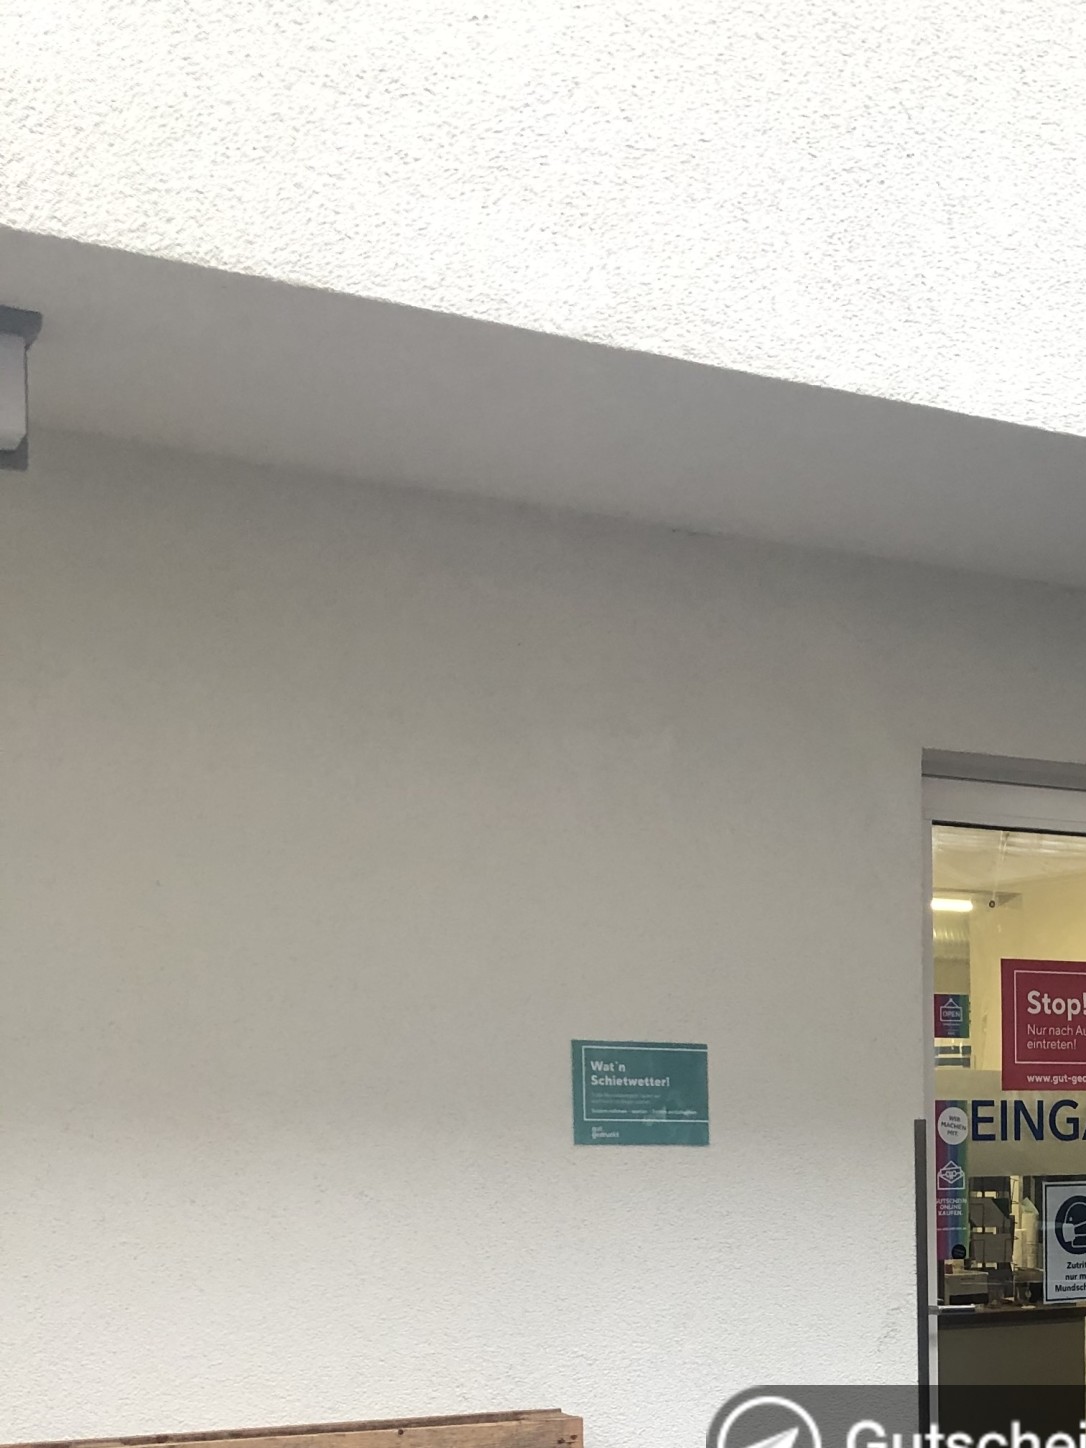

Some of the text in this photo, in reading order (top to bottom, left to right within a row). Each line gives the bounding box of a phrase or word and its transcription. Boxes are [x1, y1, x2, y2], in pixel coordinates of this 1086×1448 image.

[1027, 1024, 1047, 1036] Nur
[1049, 1025, 1073, 1036] nach
[1027, 1039, 1077, 1050] eintreten!
[590, 1075, 670, 1087] Schietwetter!
[941, 1121, 966, 1131] MACHEN
